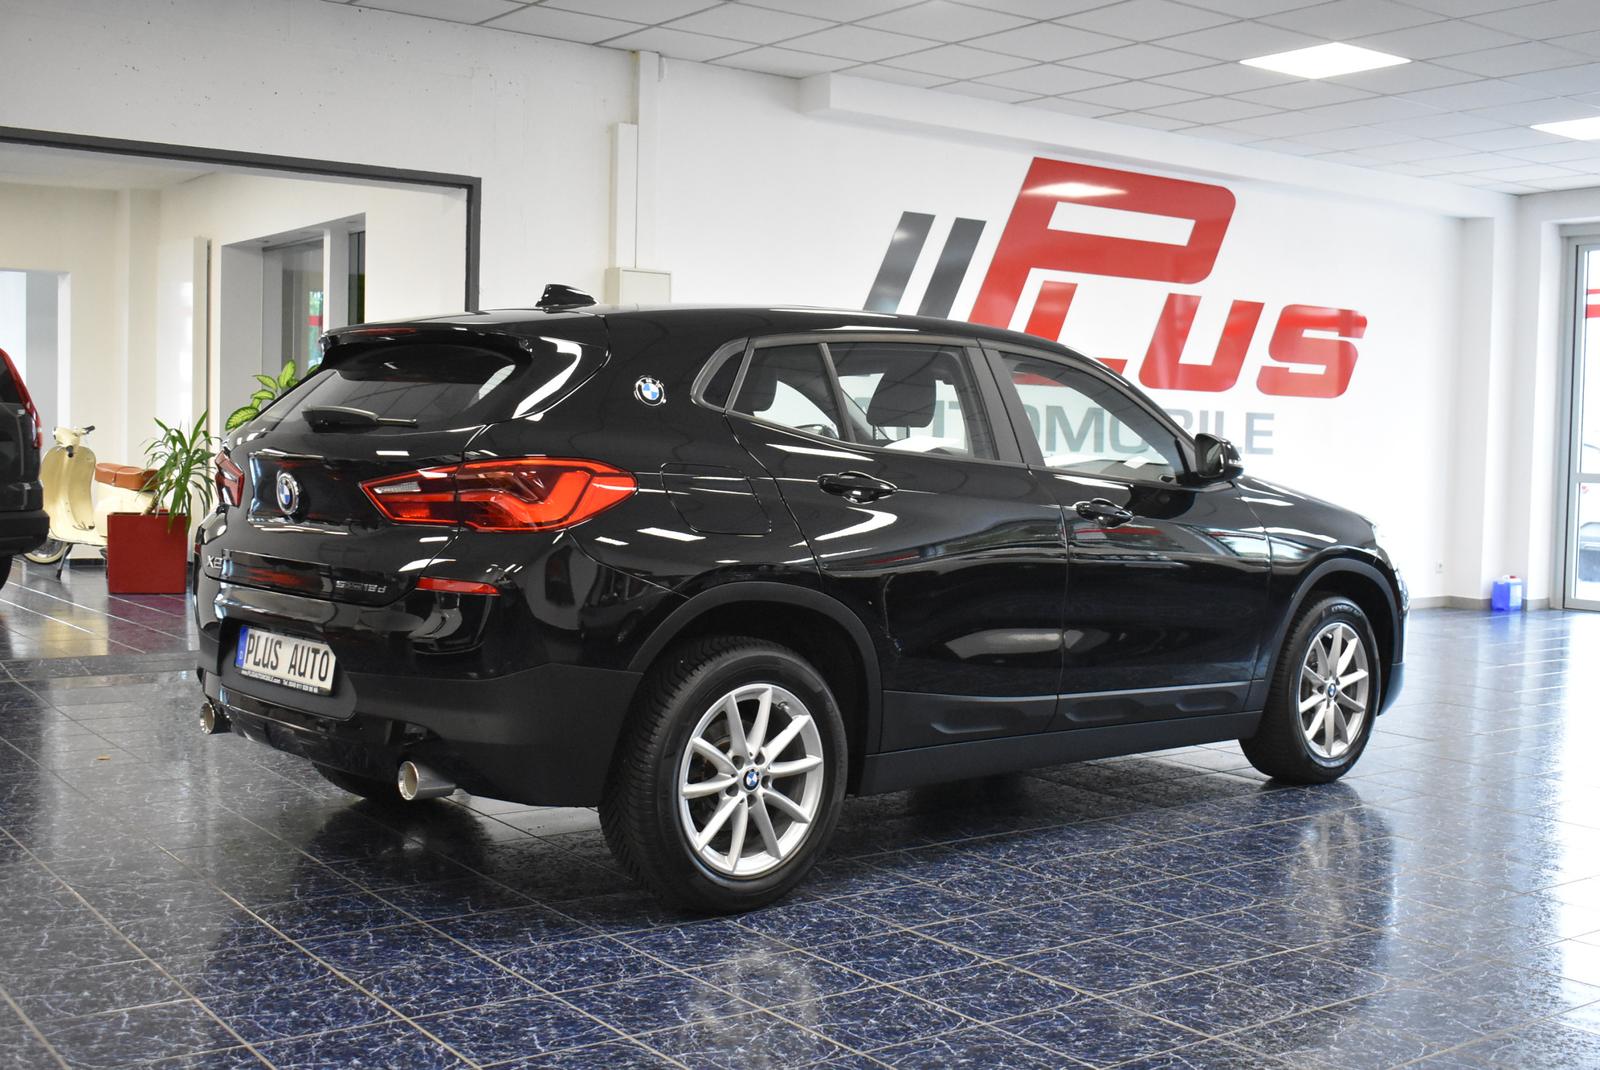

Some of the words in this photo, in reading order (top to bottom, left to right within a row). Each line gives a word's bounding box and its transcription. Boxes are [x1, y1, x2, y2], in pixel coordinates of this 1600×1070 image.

[207, 555, 223, 569] X2
[245, 634, 282, 671] PLUS
[288, 644, 330, 682] AUTO
